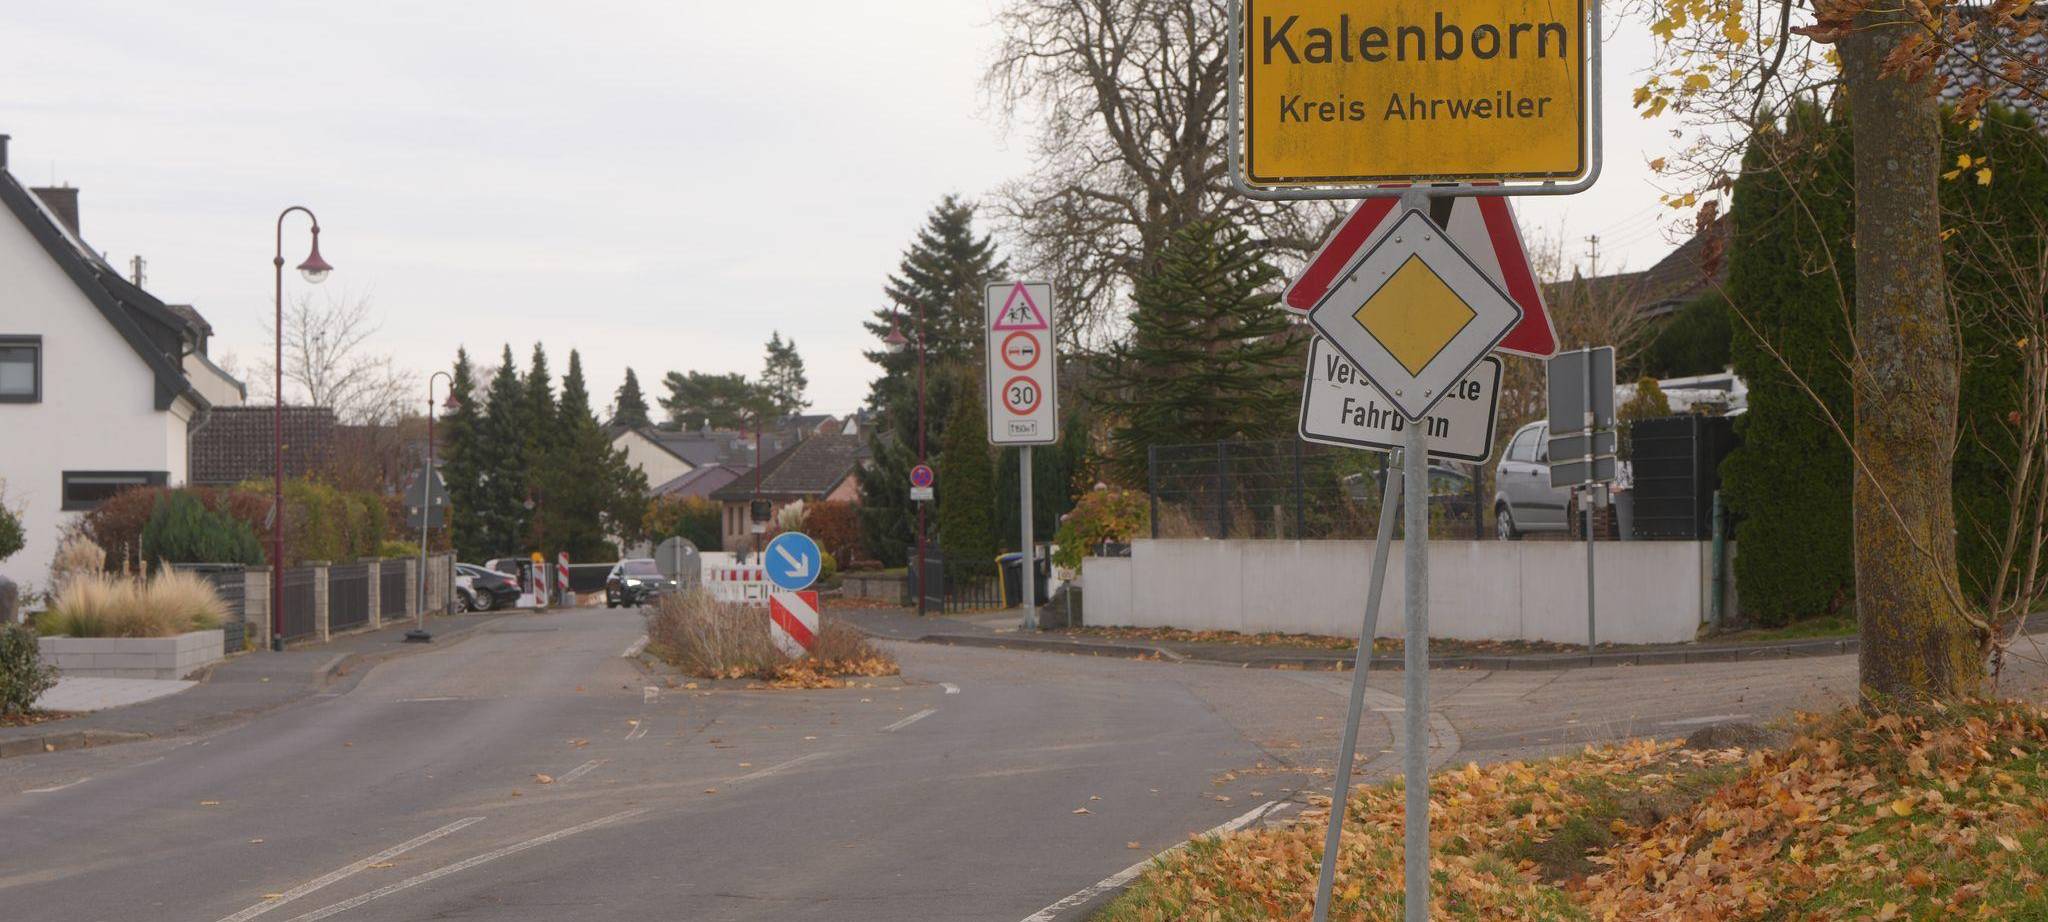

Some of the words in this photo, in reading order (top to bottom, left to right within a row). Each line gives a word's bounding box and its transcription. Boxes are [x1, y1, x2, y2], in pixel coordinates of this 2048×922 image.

[1262, 12, 1567, 65] Kalenborn
[1279, 95, 1365, 123] Kreis
[1384, 91, 1552, 121] Ahrweiler
[1010, 387, 1033, 405] 30
